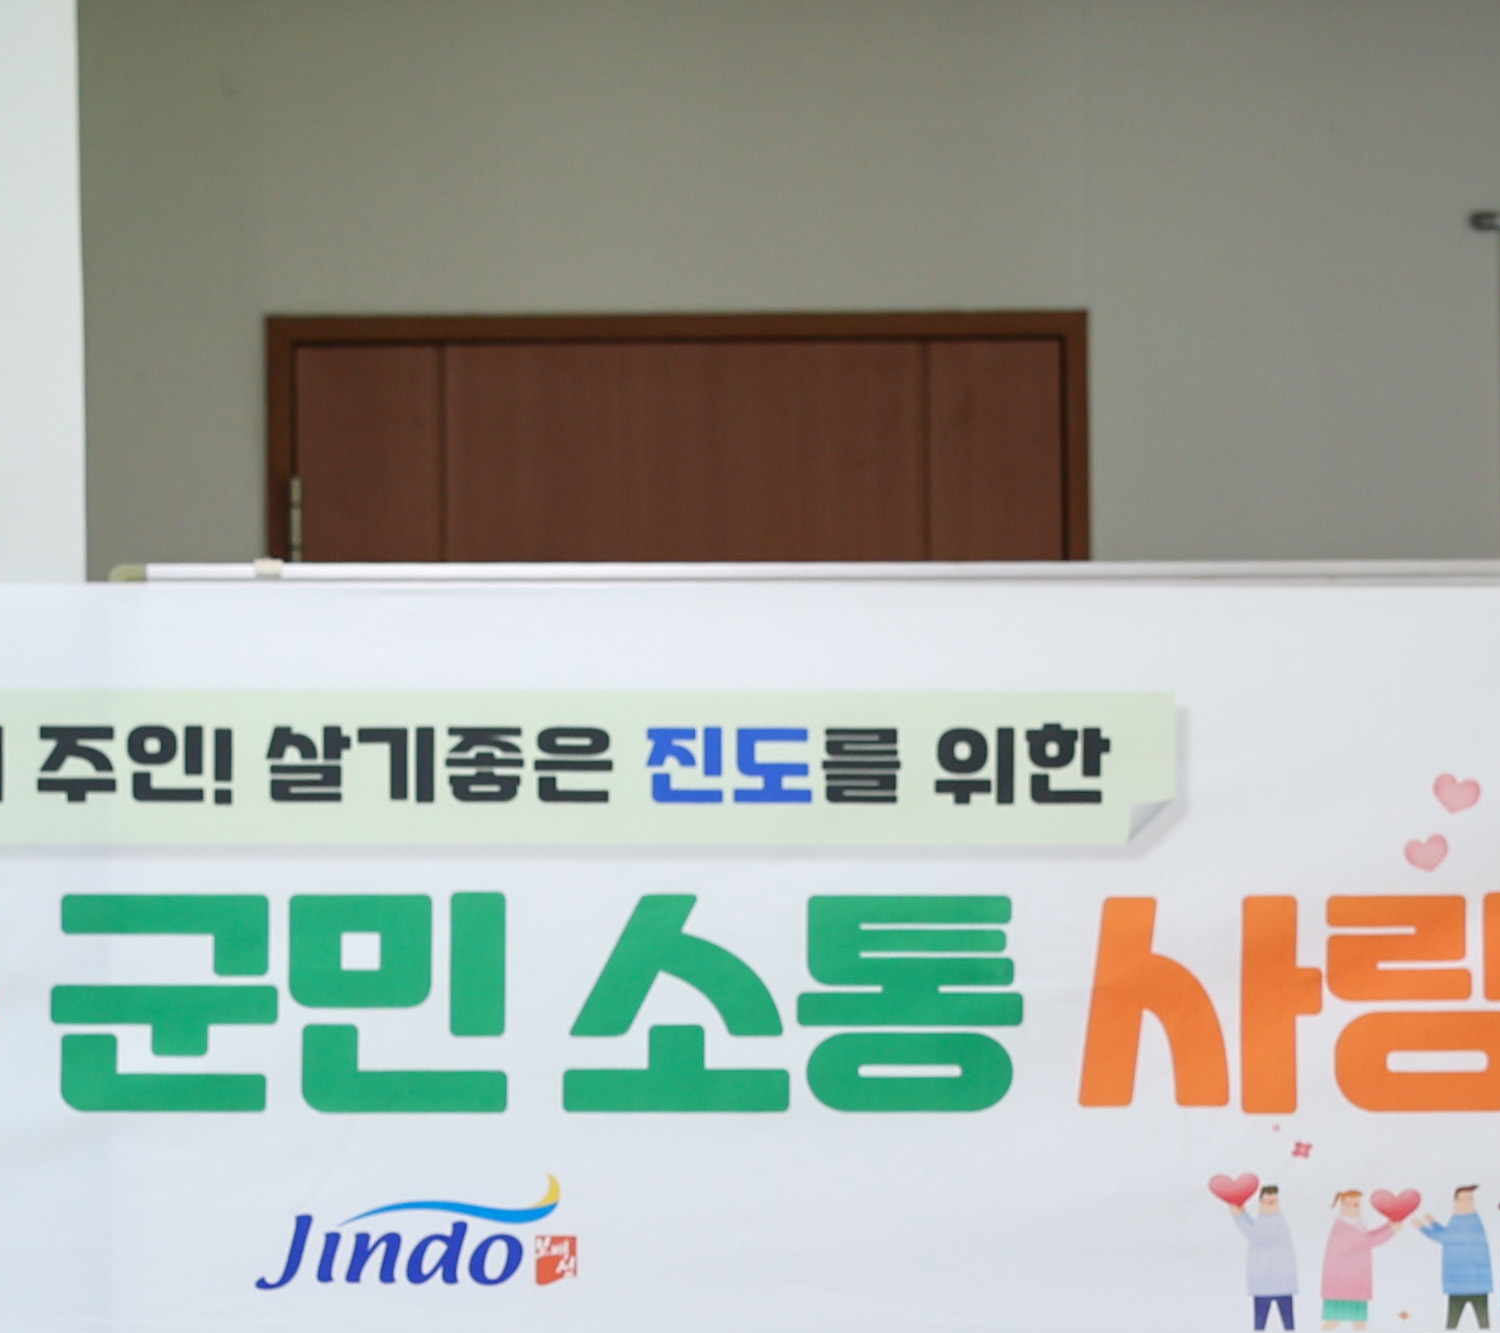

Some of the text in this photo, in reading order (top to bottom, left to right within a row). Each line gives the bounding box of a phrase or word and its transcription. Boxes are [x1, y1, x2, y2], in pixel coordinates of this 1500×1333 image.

[37, 724, 233, 805] 주인!
[266, 725, 614, 804] 살기좋은
[647, 727, 902, 804] 진도를
[935, 723, 1111, 805] 위한
[50, 892, 508, 1113] 군민
[562, 894, 1024, 1113] 소통
[255, 1214, 524, 1290] Jindo
